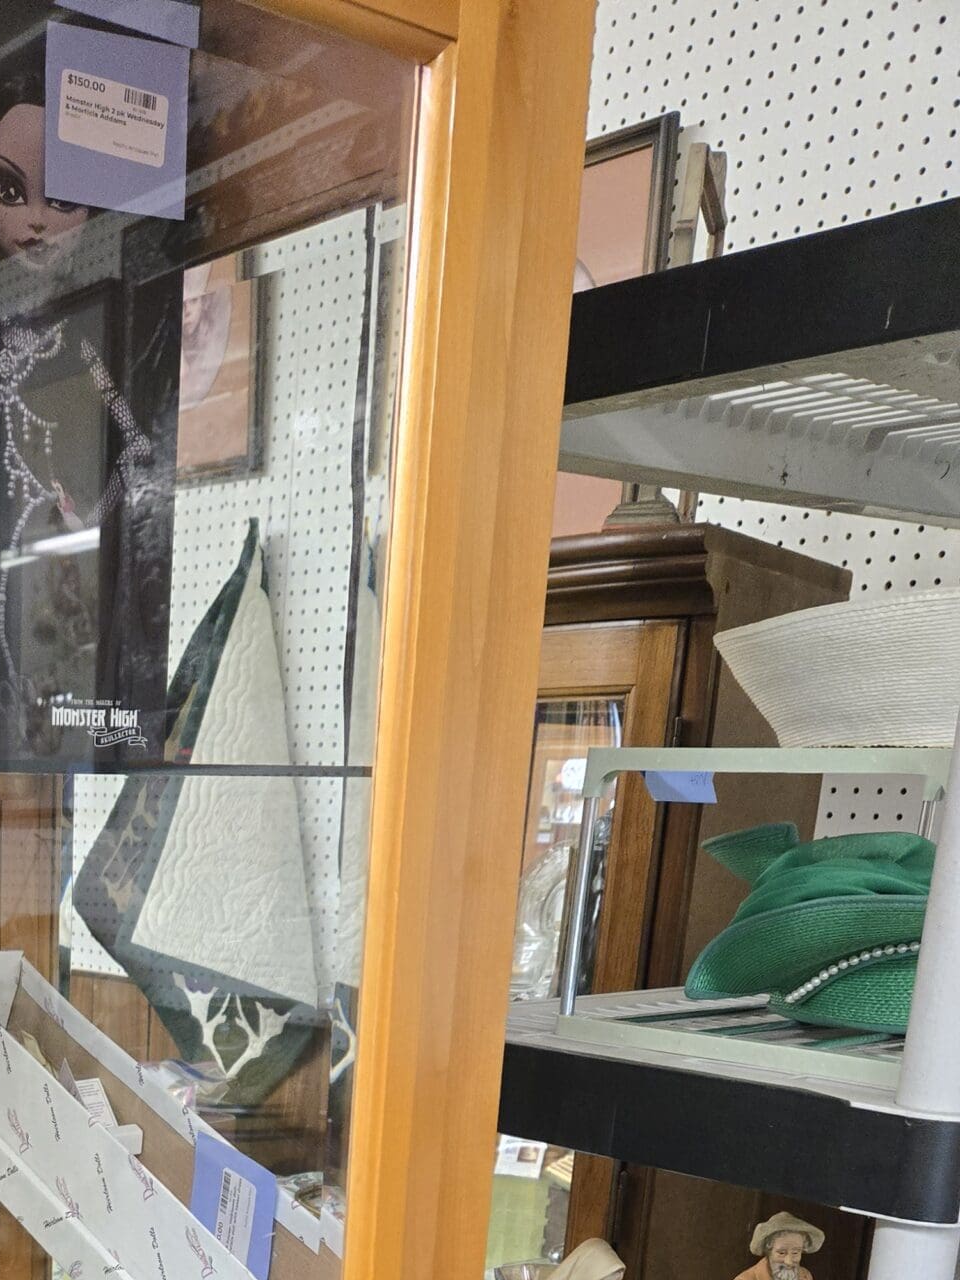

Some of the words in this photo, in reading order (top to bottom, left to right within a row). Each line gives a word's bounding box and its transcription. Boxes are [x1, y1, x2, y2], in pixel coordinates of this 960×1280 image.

[68, 74, 105, 93] $150.00
[66, 95, 93, 106] Monster
[94, 101, 110, 113] High
[126, 111, 164, 130] Wednesday
[99, 112, 127, 126] Addams
[51, 705, 106, 727] MONSTER
[110, 707, 138, 728] HIGH
